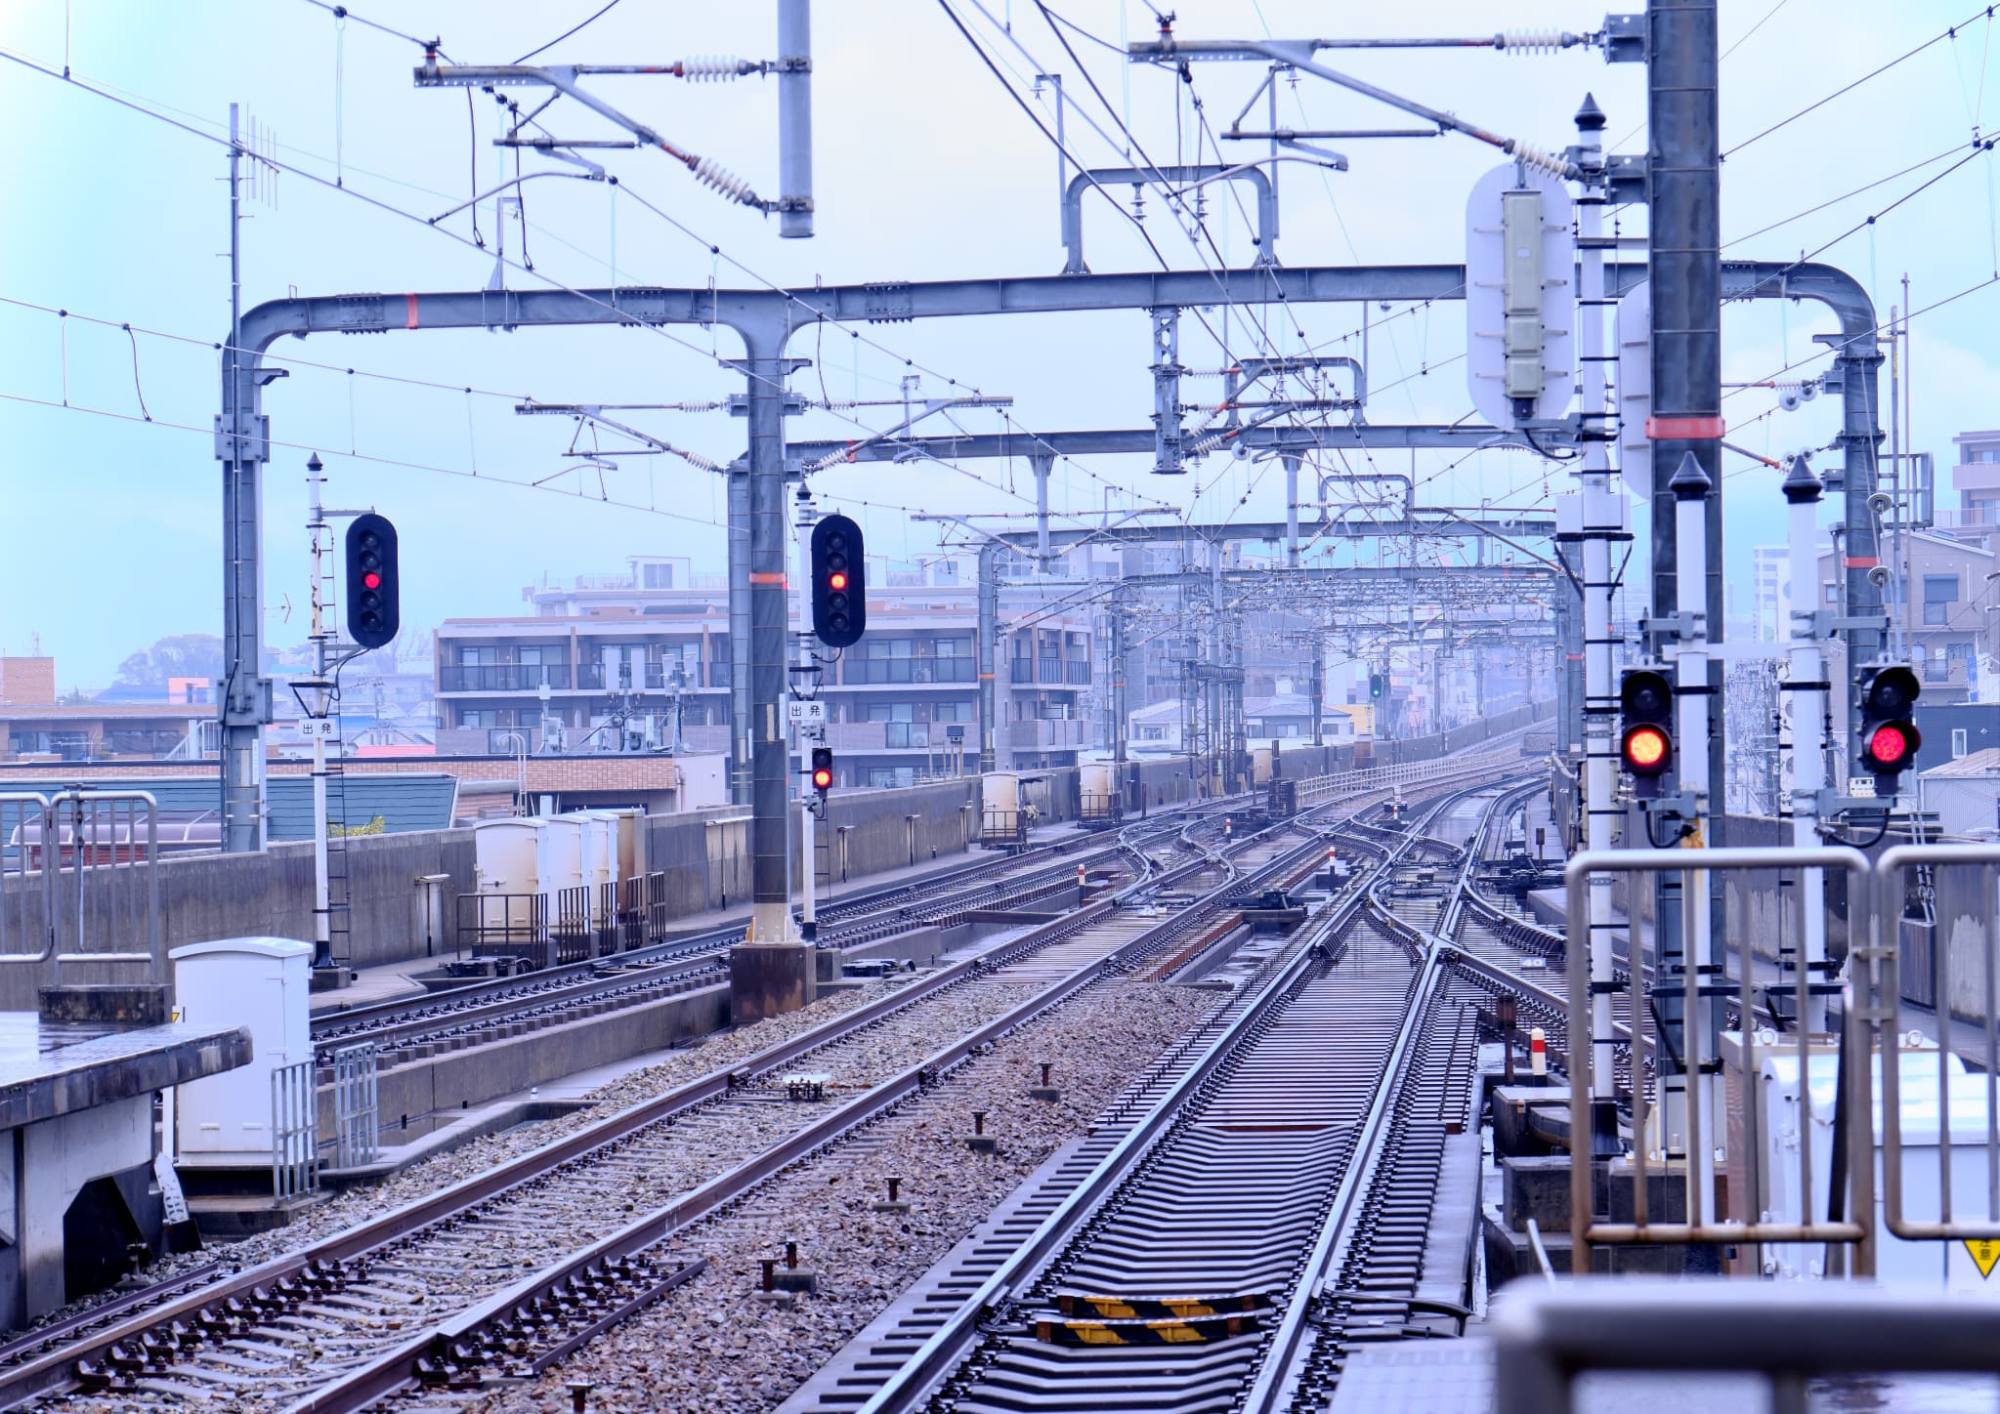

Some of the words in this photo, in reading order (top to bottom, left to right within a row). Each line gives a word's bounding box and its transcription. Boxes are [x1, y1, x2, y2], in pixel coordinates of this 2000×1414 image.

[791, 705, 820, 716] 出発
[303, 723, 331, 734] 出発
[1521, 959, 1543, 967] 40
